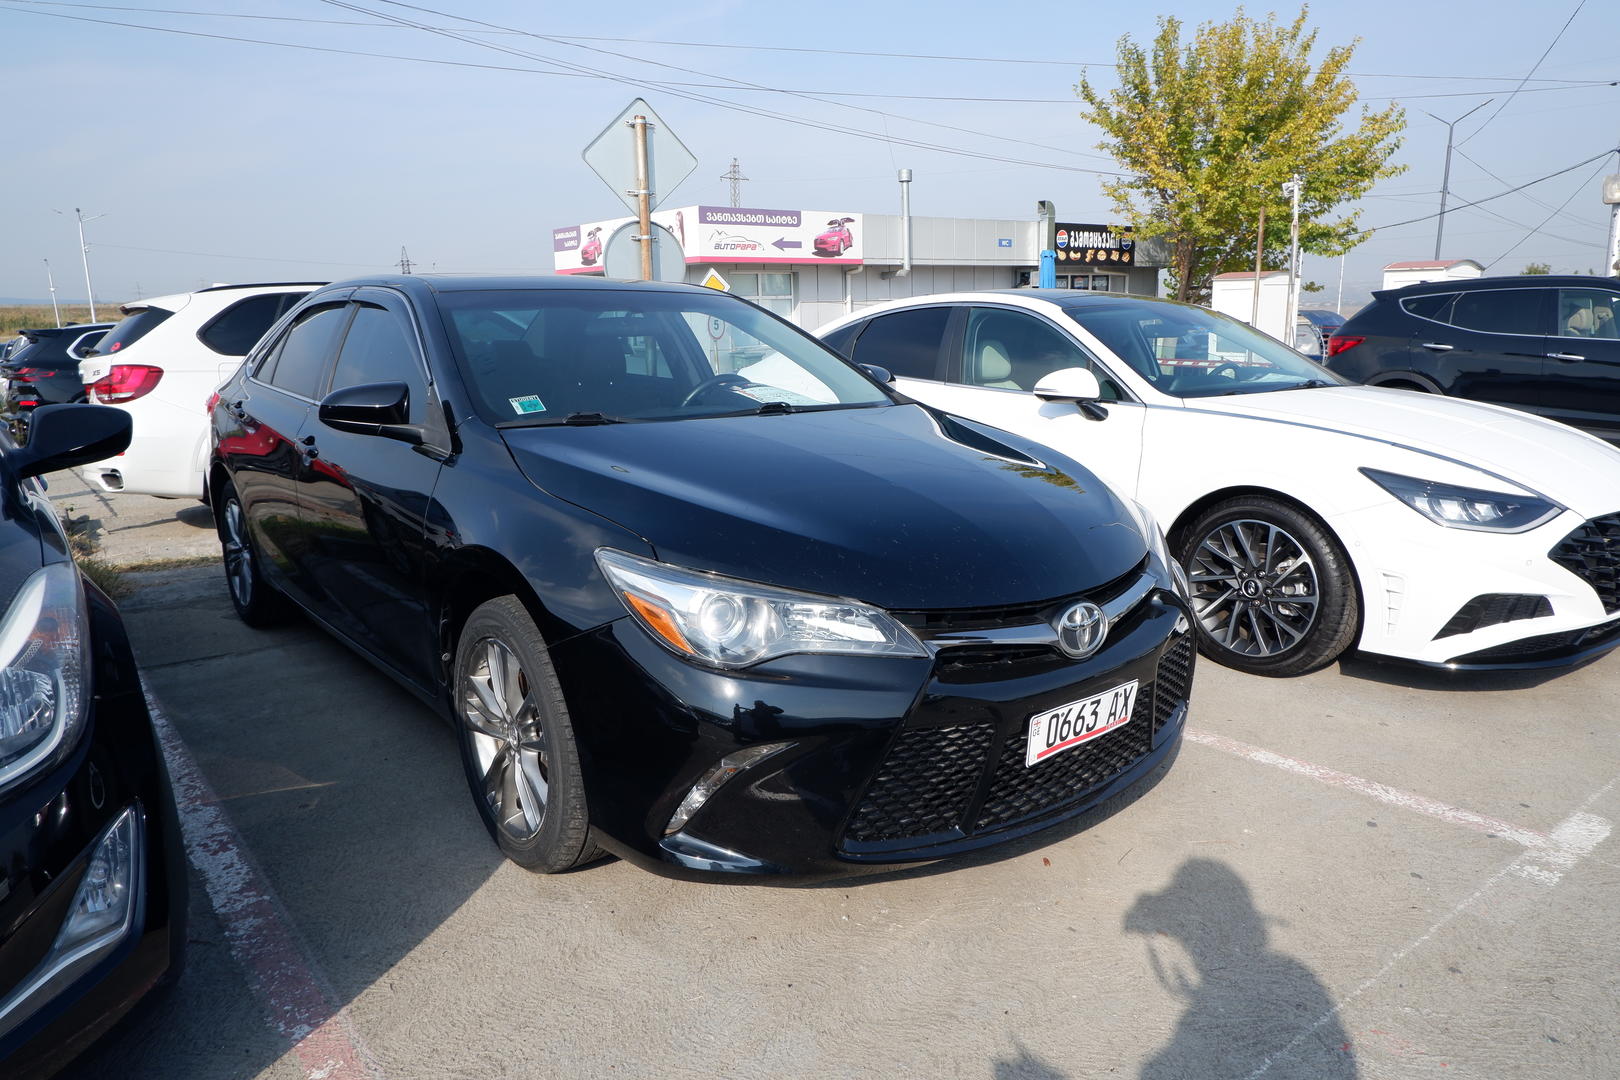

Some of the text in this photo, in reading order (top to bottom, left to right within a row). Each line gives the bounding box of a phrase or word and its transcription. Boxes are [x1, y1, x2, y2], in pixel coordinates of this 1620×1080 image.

[766, 214, 798, 225] საიტზე
[714, 320, 719, 330] 5
[1046, 686, 1133, 748] 0663 AX
